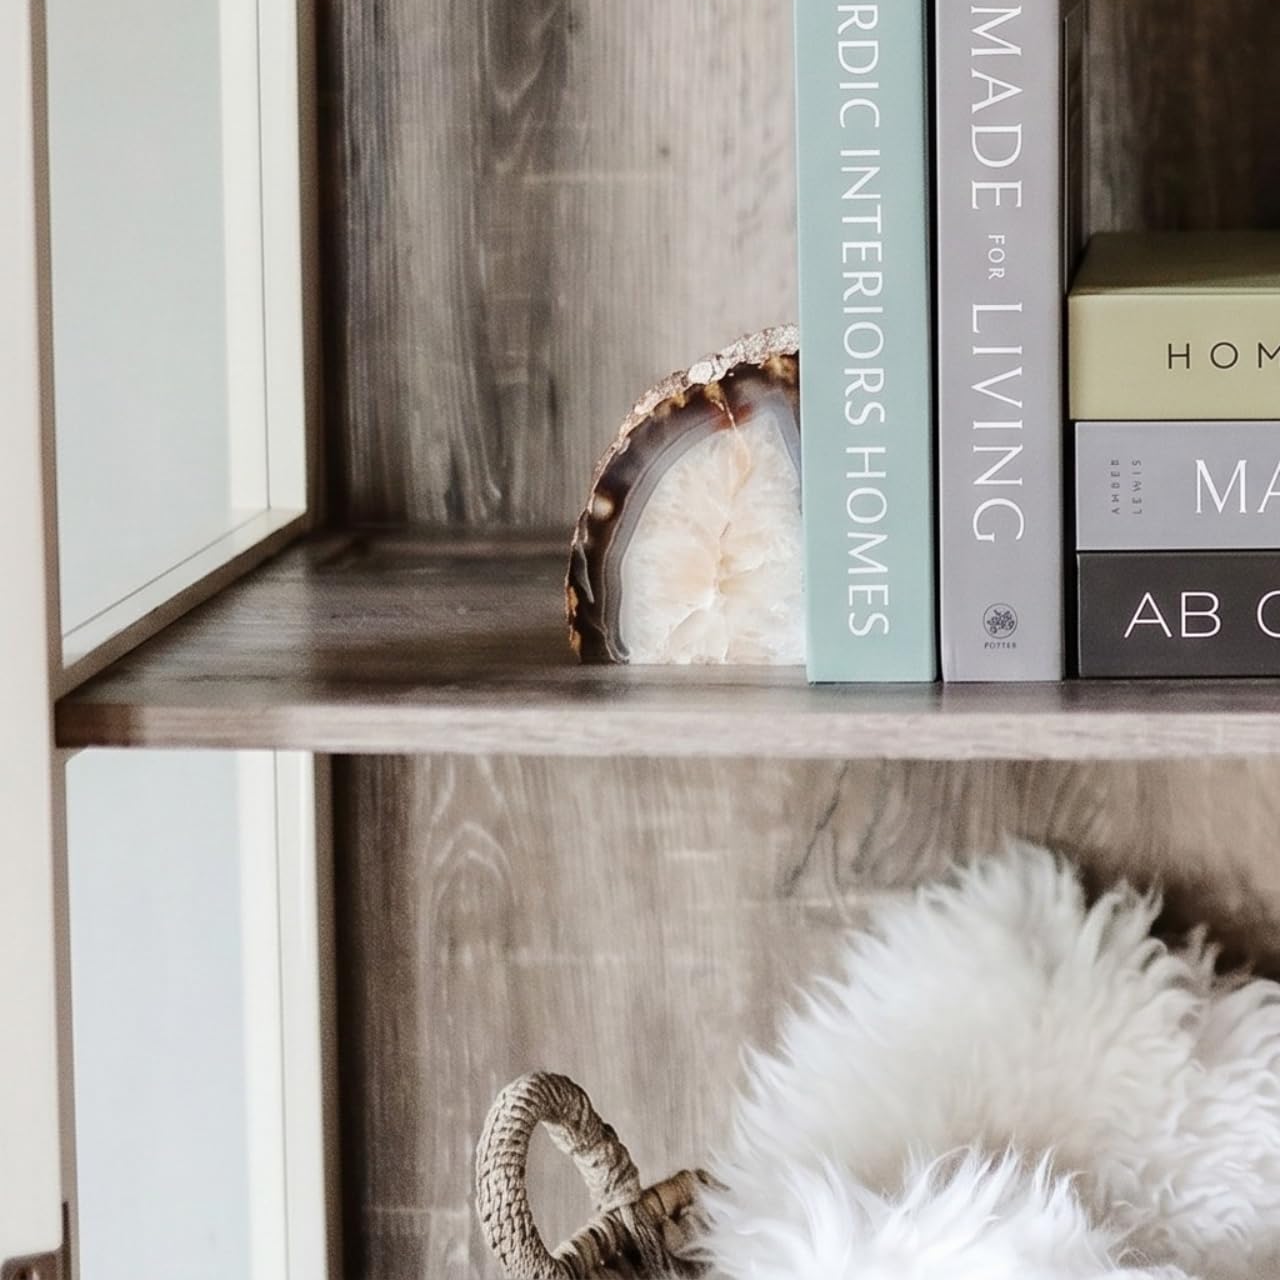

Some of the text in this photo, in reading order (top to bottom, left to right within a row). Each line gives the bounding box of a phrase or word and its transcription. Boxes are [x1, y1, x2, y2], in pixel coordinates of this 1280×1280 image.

[840, 149, 886, 429] INTERIORS
[970, 5, 1025, 542] MADE FOR LIVING
[845, 446, 890, 636] HOMES
[1124, 591, 1222, 638] AB
